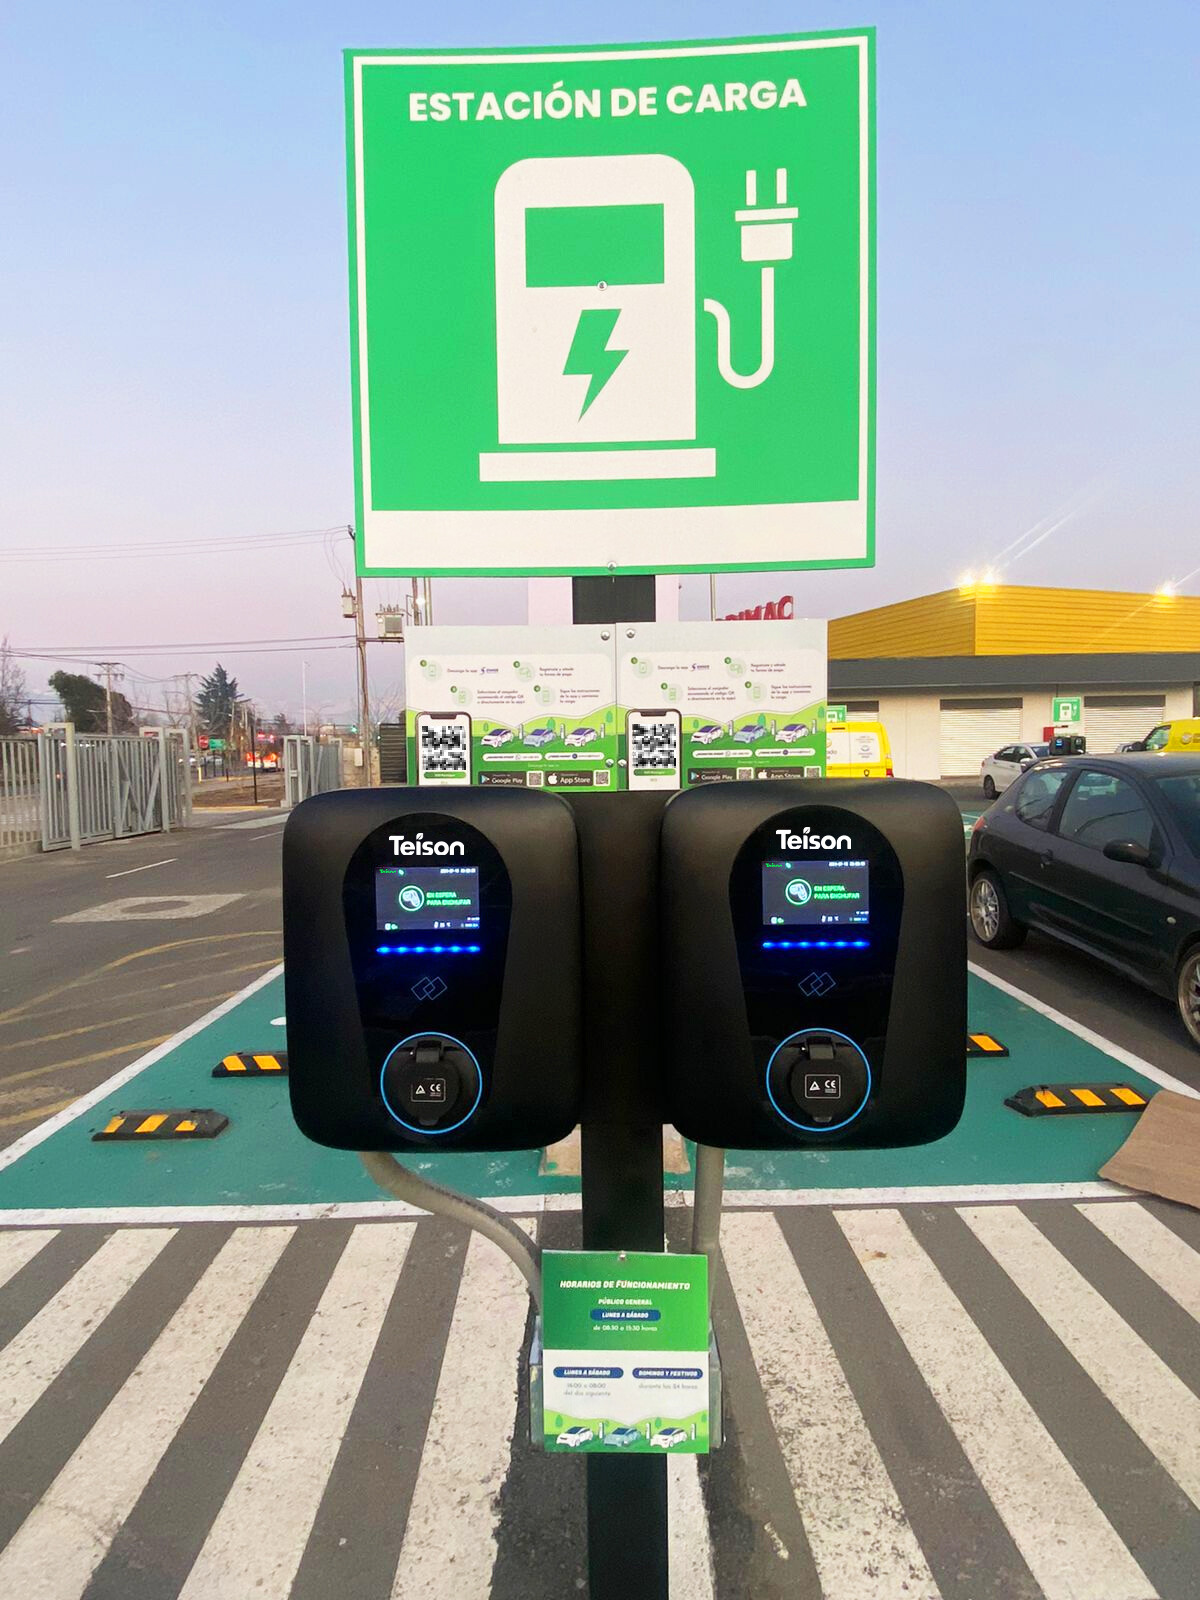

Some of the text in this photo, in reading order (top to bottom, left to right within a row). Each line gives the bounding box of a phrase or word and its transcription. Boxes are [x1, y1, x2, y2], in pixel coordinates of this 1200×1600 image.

[409, 78, 807, 122] ESTACIÓN DE CARGA
[776, 827, 851, 850] Teison
[388, 832, 464, 856] Teison
[430, 1084, 441, 1092] CE
[825, 1080, 836, 1088] CE
[616, 1280, 690, 1290] FUNCIONAMIENTO
[598, 1297, 624, 1305] PÚBLICO
